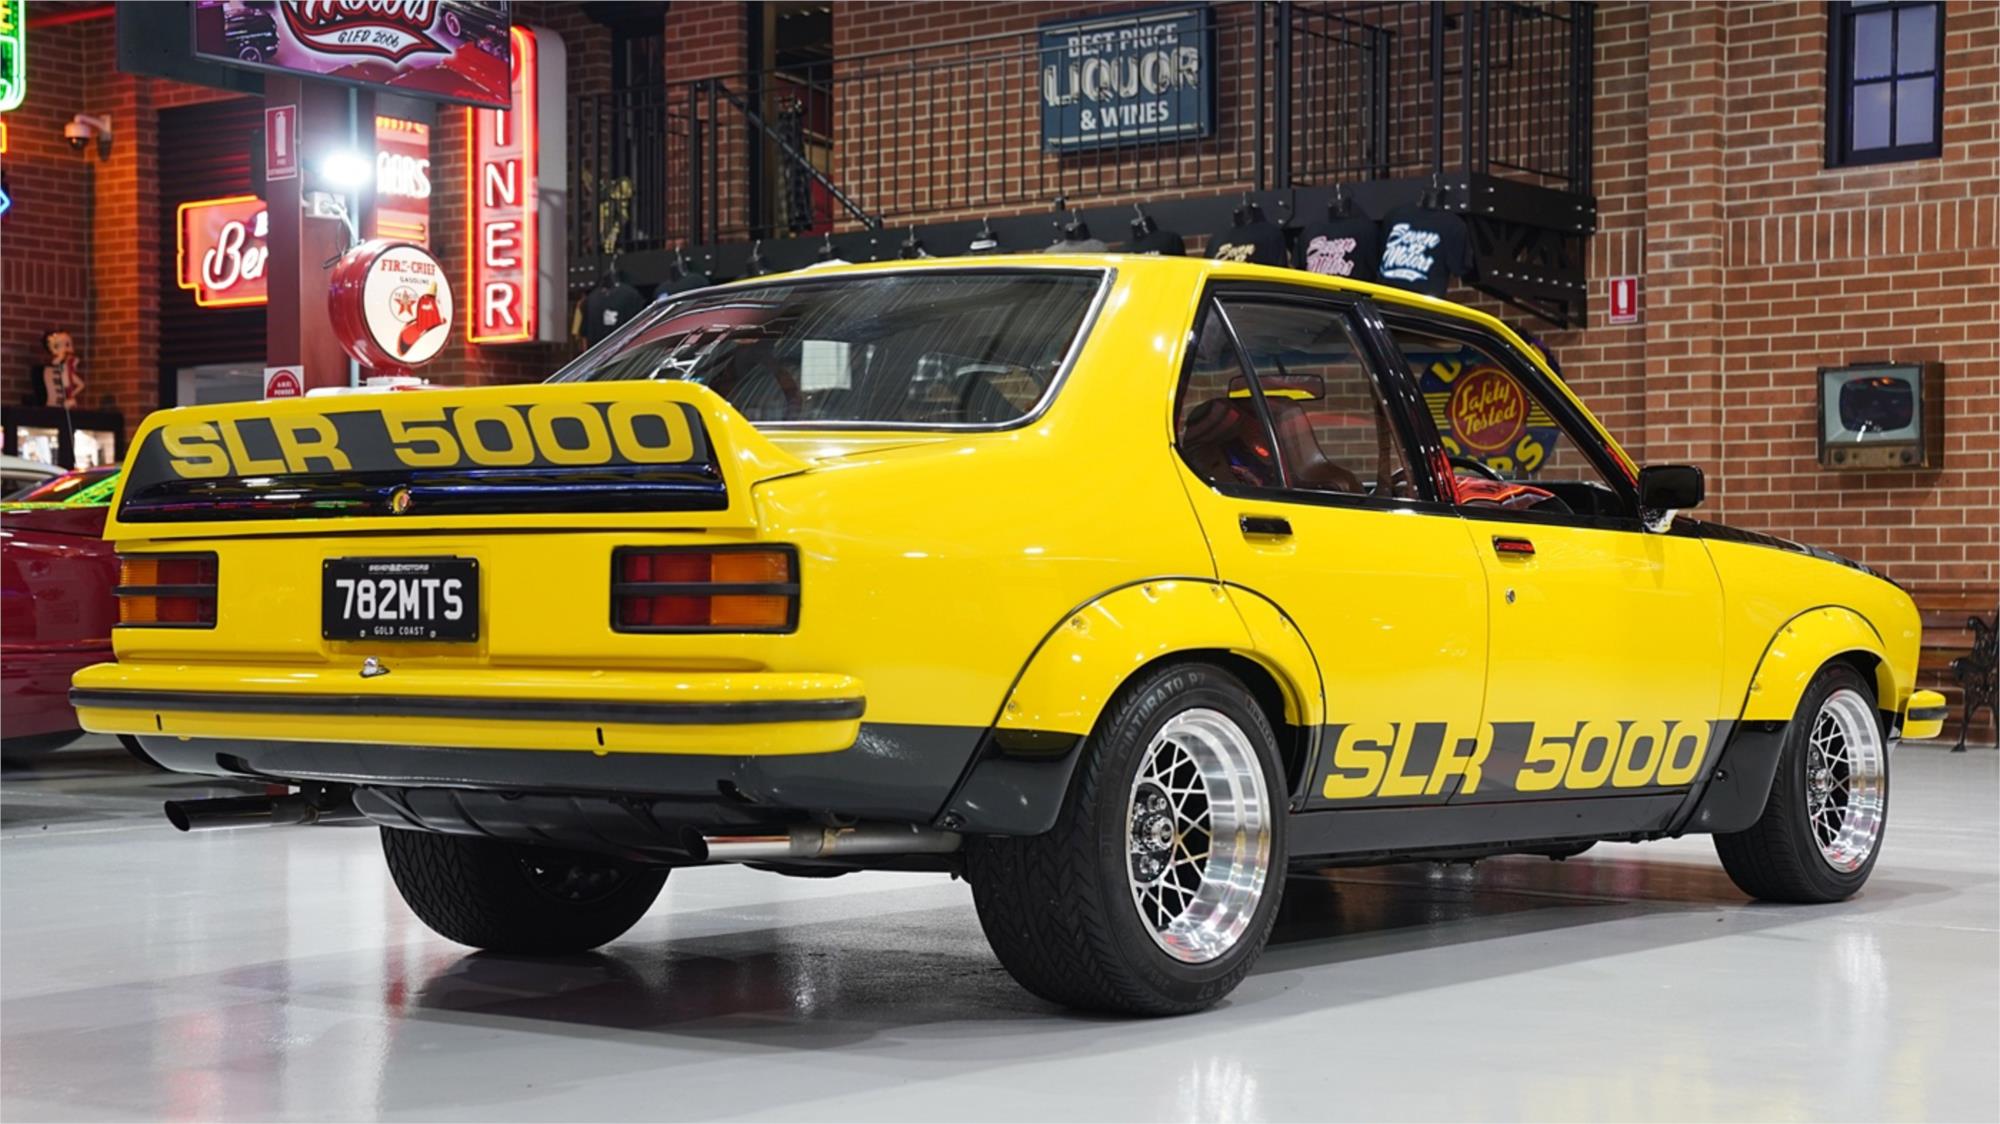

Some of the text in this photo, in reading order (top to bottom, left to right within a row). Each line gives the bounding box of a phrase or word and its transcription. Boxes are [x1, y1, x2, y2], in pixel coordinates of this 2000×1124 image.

[1068, 23, 1178, 58] BEST PRICE
[1044, 46, 1199, 107] LIQUOR
[1080, 101, 1169, 131] & WINES
[1459, 379, 1510, 418] Safety
[1464, 398, 1517, 436] Tested
[161, 401, 694, 479] SLR 5000
[336, 578, 463, 620] 782MTS
[373, 625, 425, 636] GOLD COAST
[1323, 721, 1494, 799] SLR
[1515, 720, 1711, 792] 5000
